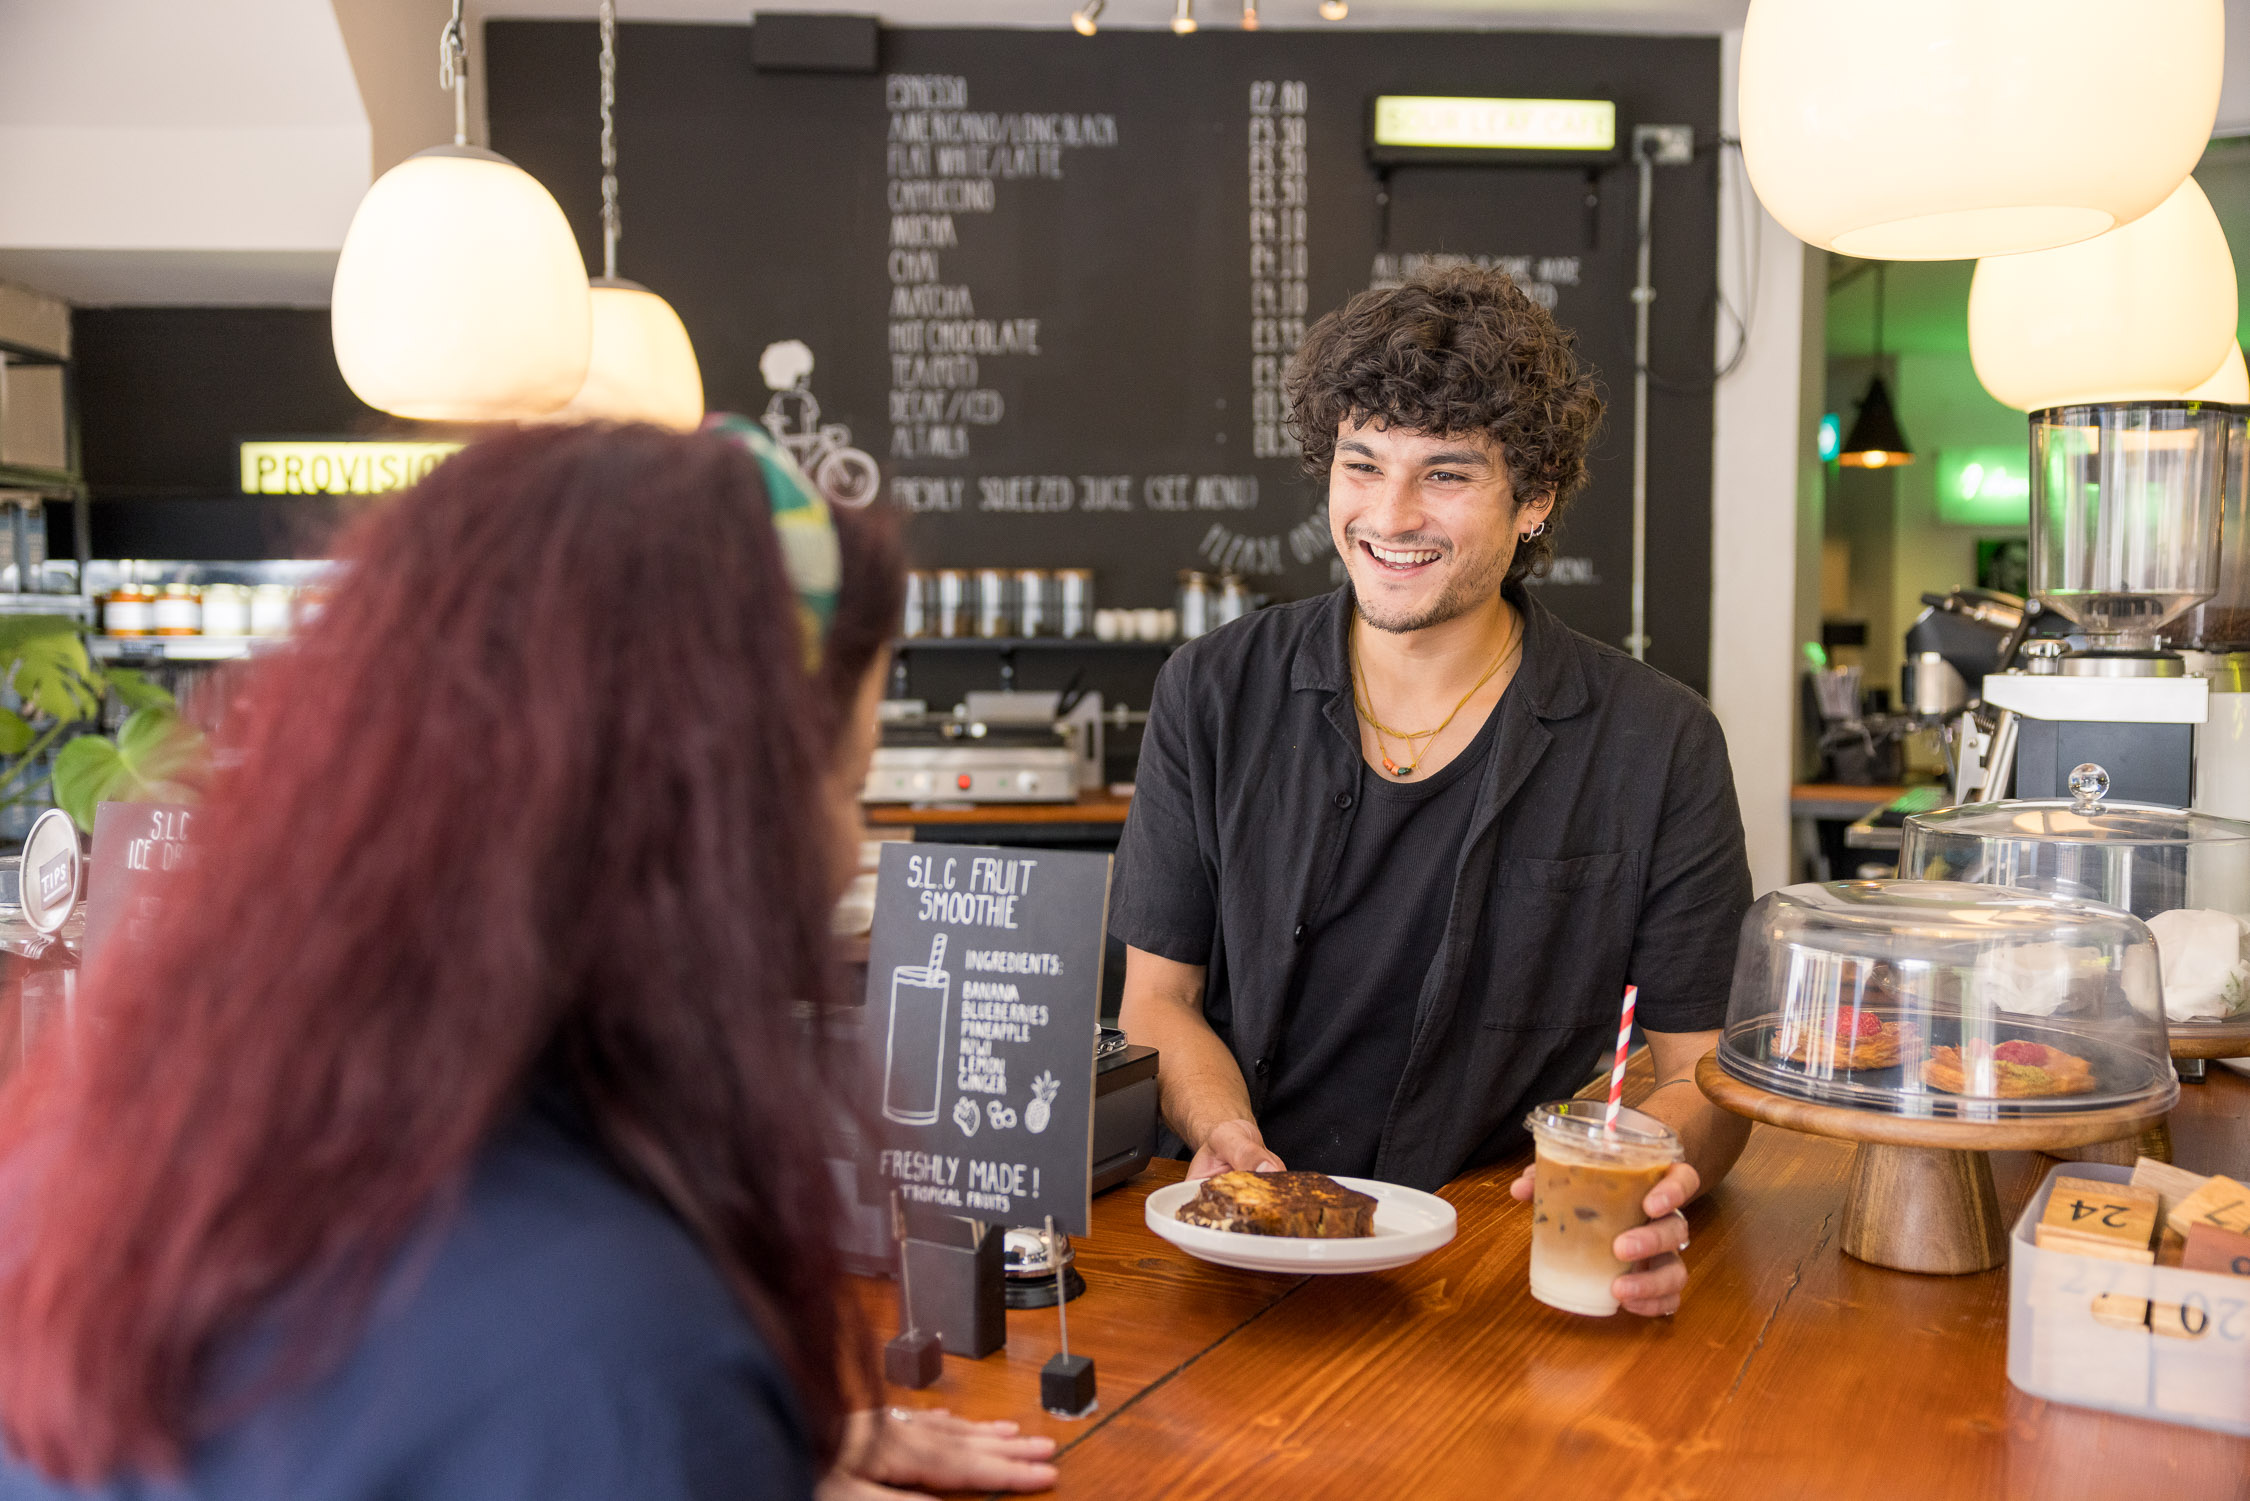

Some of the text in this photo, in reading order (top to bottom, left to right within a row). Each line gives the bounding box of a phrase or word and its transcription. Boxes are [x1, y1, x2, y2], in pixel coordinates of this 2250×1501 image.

[127, 838, 153, 871] ICE
[40, 862, 67, 895] TIPS
[969, 857, 1038, 896] FRUIT
[918, 890, 1019, 929] SMOOTHIE
[964, 949, 1064, 976] INGREDIENTS:
[962, 980, 1020, 1002] BANANA
[961, 1000, 1049, 1027] BLUEBERRIES
[960, 1020, 1031, 1043] PINEAPPLE
[960, 1038, 993, 1057] KIWI
[958, 1055, 1006, 1075] LEMON
[957, 1073, 1007, 1096] GINGER
[880, 1149, 959, 1186] FRESHLY
[902, 1184, 1011, 1213] TROPICAL FRUITS
[2070, 1199, 2130, 1228] 24
